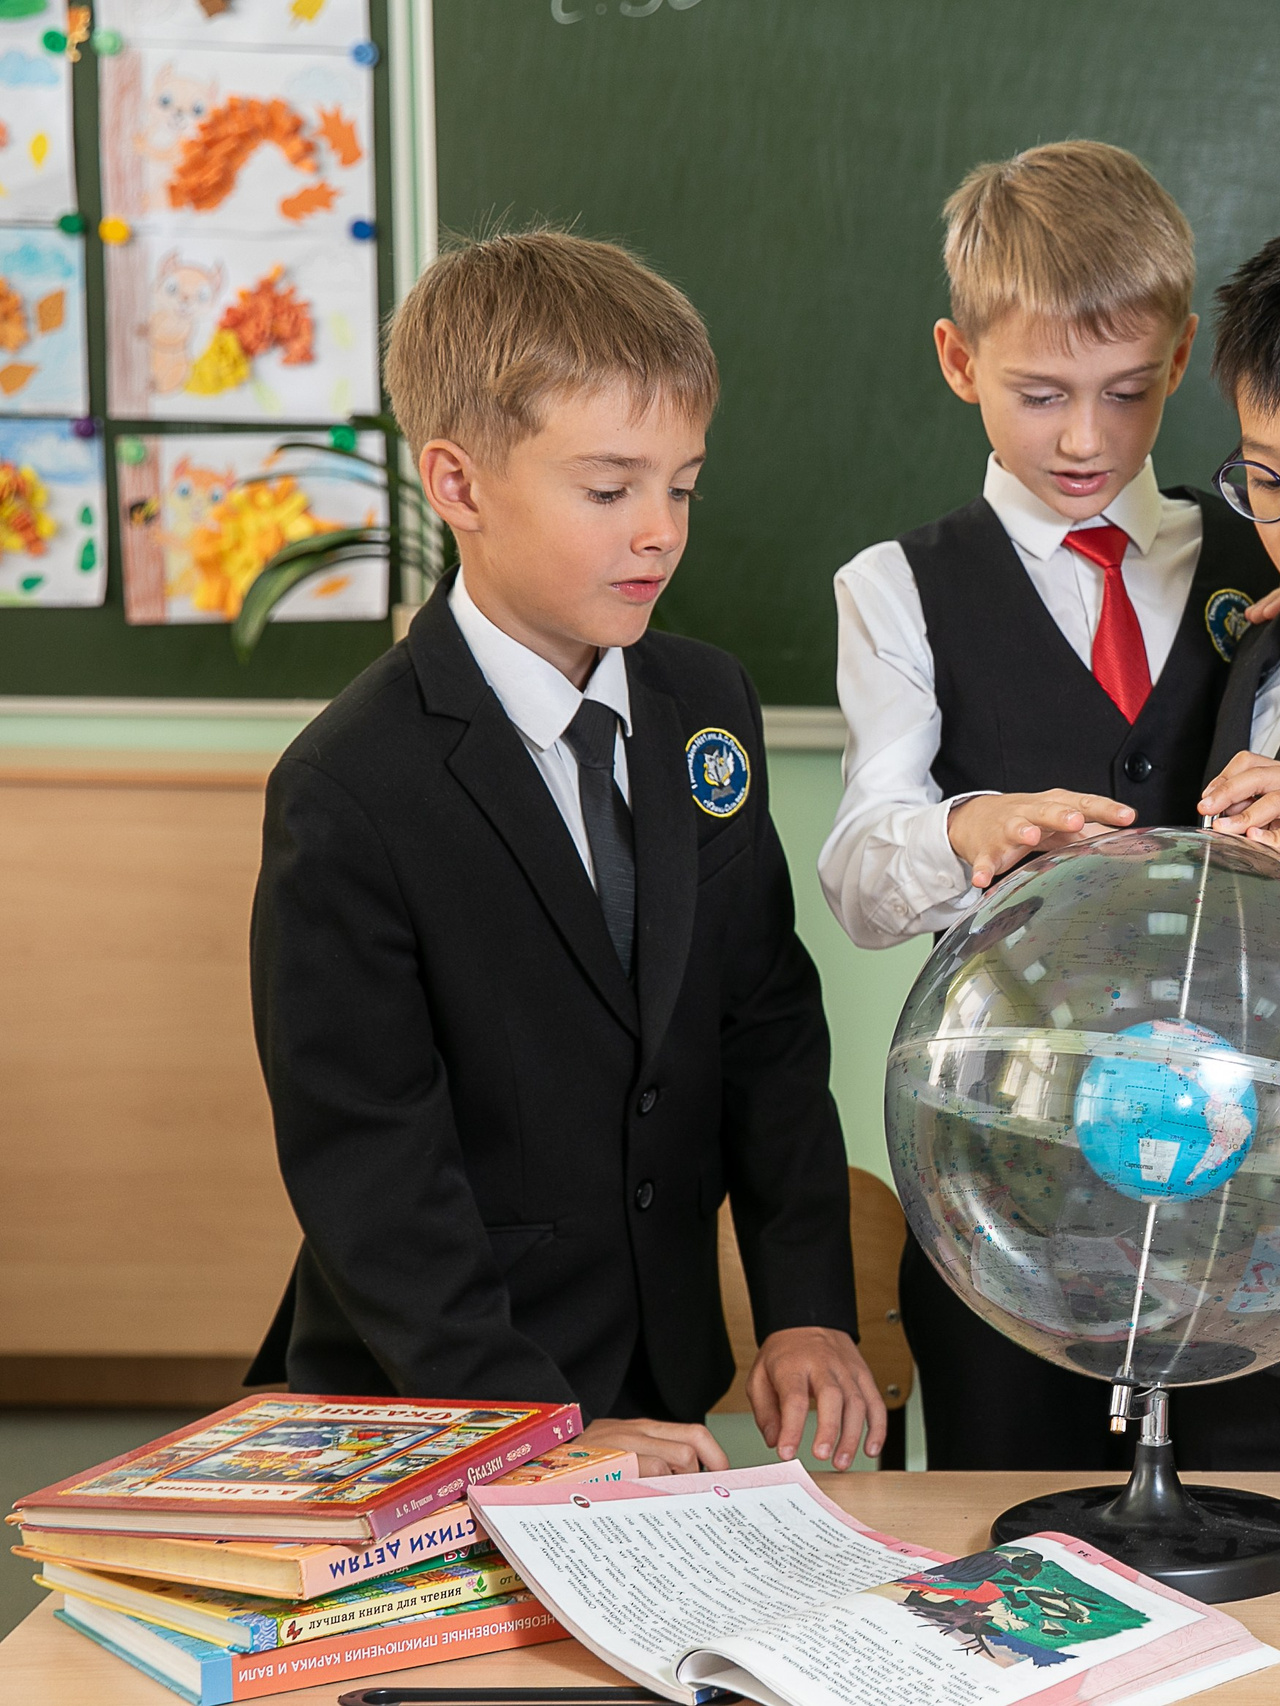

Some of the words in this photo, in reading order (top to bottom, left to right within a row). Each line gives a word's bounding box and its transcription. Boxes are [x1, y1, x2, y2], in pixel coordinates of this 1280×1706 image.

[467, 1456, 504, 1486] Сказки
[409, 1518, 478, 1553] СТИХИ
[329, 1540, 401, 1579] ДЕТЯМ
[308, 1612, 355, 1630] лучшая
[358, 1602, 393, 1619] книга
[396, 1597, 417, 1612] для
[420, 1585, 462, 1605] чтения
[442, 1612, 555, 1644] НЕОБЫКНОВЕННЫЕ
[345, 1633, 438, 1662] ПРИКЛЮЧЕНИЯ
[238, 1666, 274, 1682] ВАЛИ
[277, 1661, 288, 1674] И
[291, 1652, 341, 1675] КАРИКА
